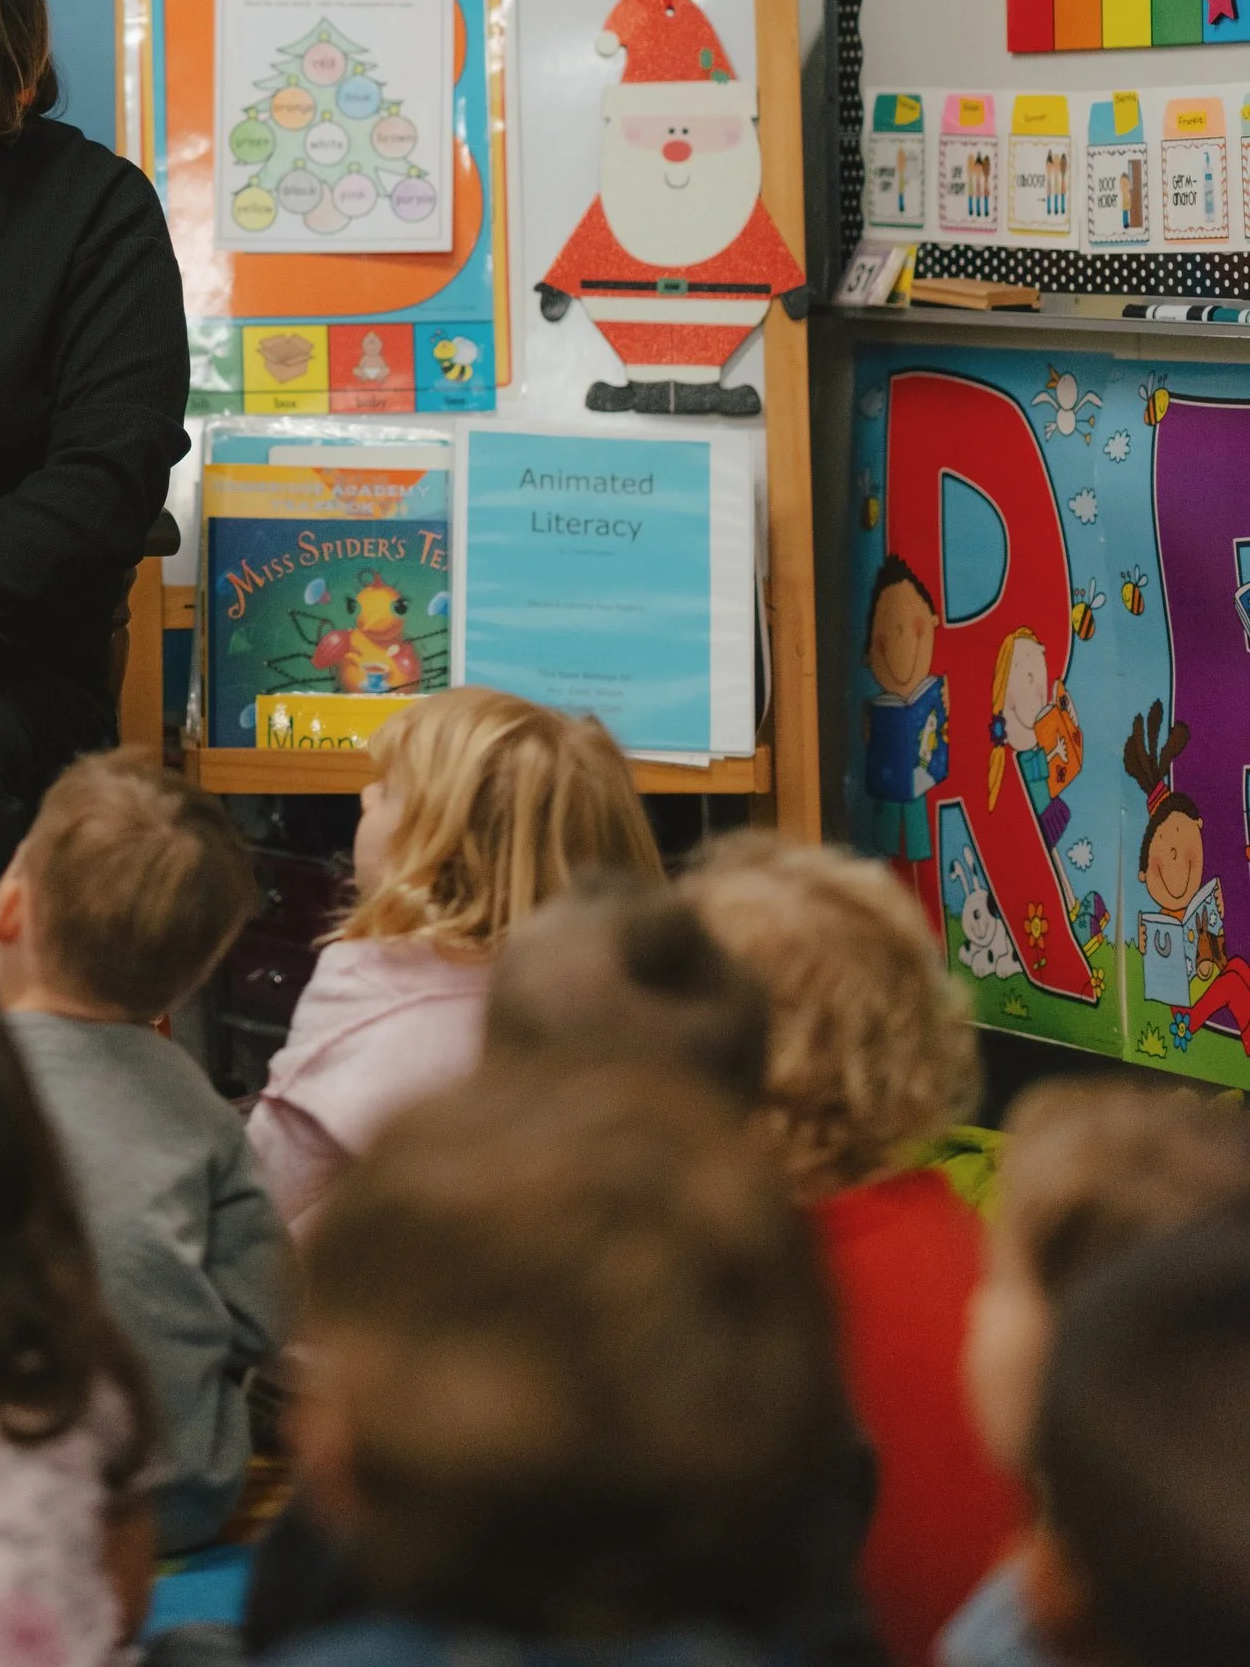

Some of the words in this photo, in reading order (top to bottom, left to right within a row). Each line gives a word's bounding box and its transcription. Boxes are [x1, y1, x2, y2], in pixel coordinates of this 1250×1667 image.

[519, 468, 654, 495] Animated
[531, 511, 642, 542] Literacy
[226, 553, 295, 619] MISS
[418, 529, 449, 572] TE
